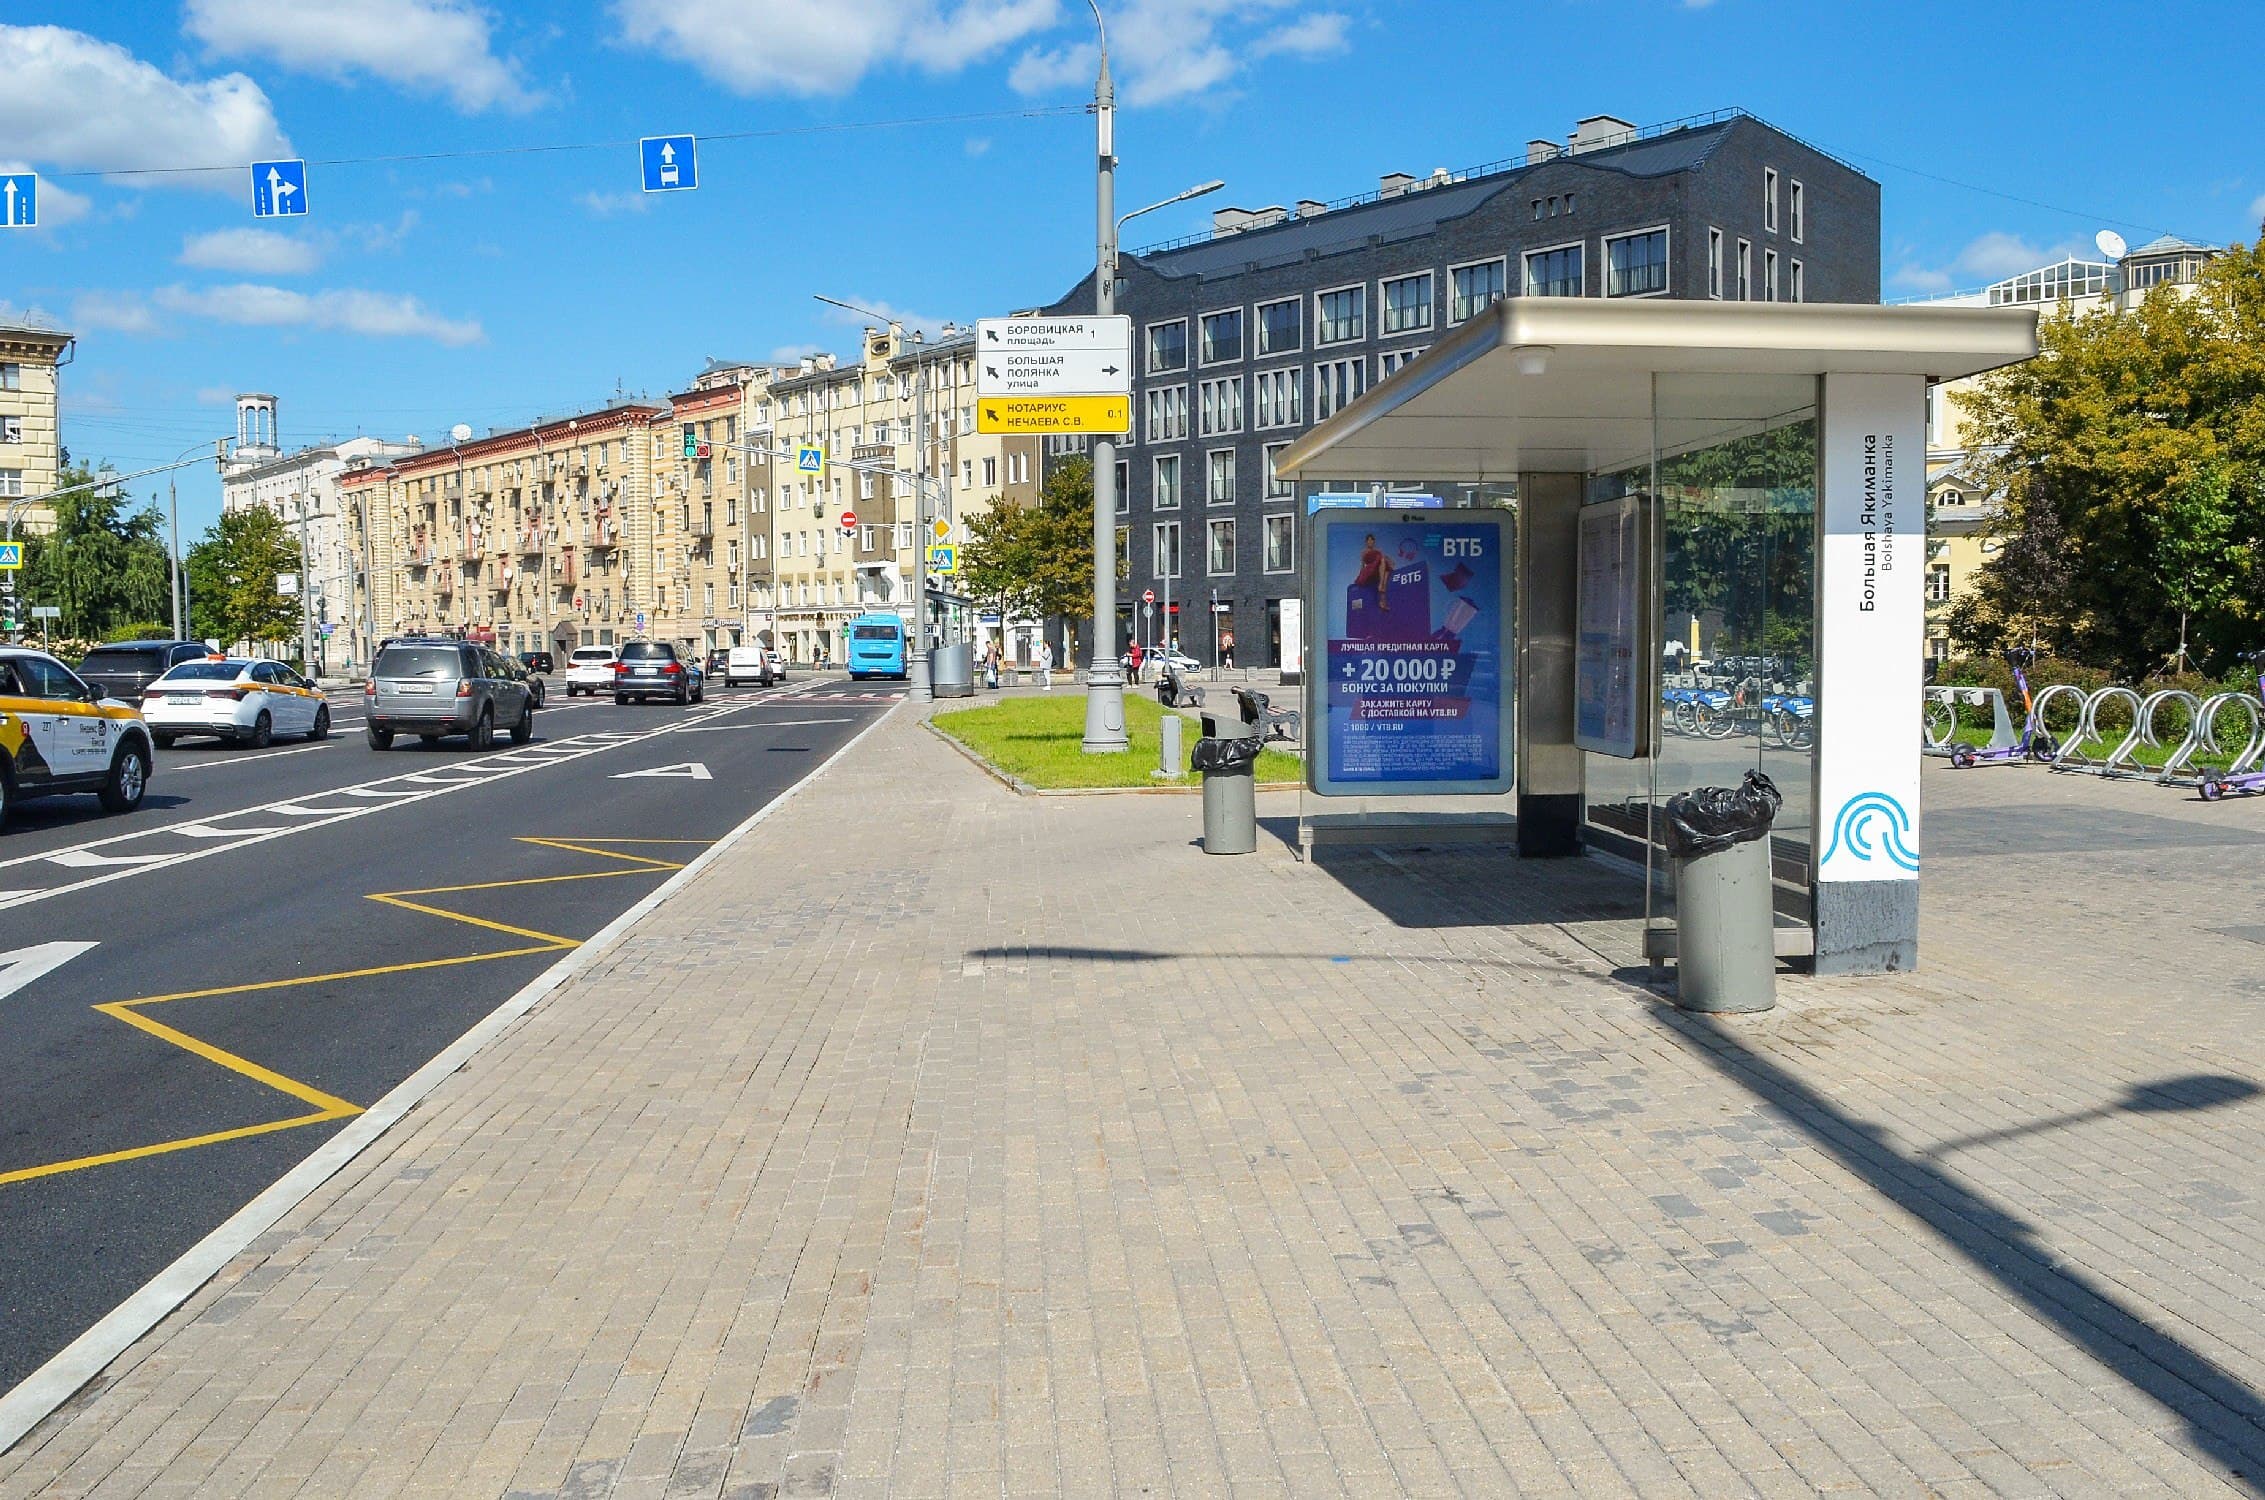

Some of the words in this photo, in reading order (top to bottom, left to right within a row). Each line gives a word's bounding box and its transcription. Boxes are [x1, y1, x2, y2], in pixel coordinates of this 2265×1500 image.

[1007, 325, 1084, 335] БОРОВИЦКАЯ
[1090, 330, 1095, 339] 1
[1007, 337, 1055, 345] площадь
[1007, 356, 1064, 365] БОЛЬШАЯ
[1007, 368, 1060, 377] ПОЛЯНКА
[1007, 381, 1039, 389] улица
[1007, 404, 1067, 412] НОТАРИУС
[1107, 409, 1122, 418] 0.1
[1007, 418, 1059, 427] НЕЧАЕВА
[1062, 417, 1084, 426] С.В.
[1882, 434, 1893, 508] Yakimanka
[1861, 434, 1876, 526] Якиманка
[1882, 512, 1895, 571] Bolshaya
[1443, 537, 1483, 557] ВТБ
[1860, 531, 1876, 611] Большая
[1400, 570, 1422, 585] ВТБ
[1340, 643, 1375, 652] ЛУЧШАЯ
[1377, 643, 1423, 651] КРЕДИТНАЯ
[1424, 643, 1449, 651] КАРТА
[1342, 683, 1378, 693] БОНУС
[1380, 683, 1394, 693] ЗА
[1397, 682, 1448, 693] ПОКУПКИ
[1360, 700, 1405, 708] ЗАКАЖИТЕ
[1406, 700, 1432, 708] КАРТУ
[1361, 709, 1366, 717] С
[1367, 708, 1414, 717] ДОСТАВКОЙ
[1416, 709, 1429, 717] НА
[1430, 709, 1458, 717] VTB.RU
[1376, 723, 1403, 731] VTB.RU
